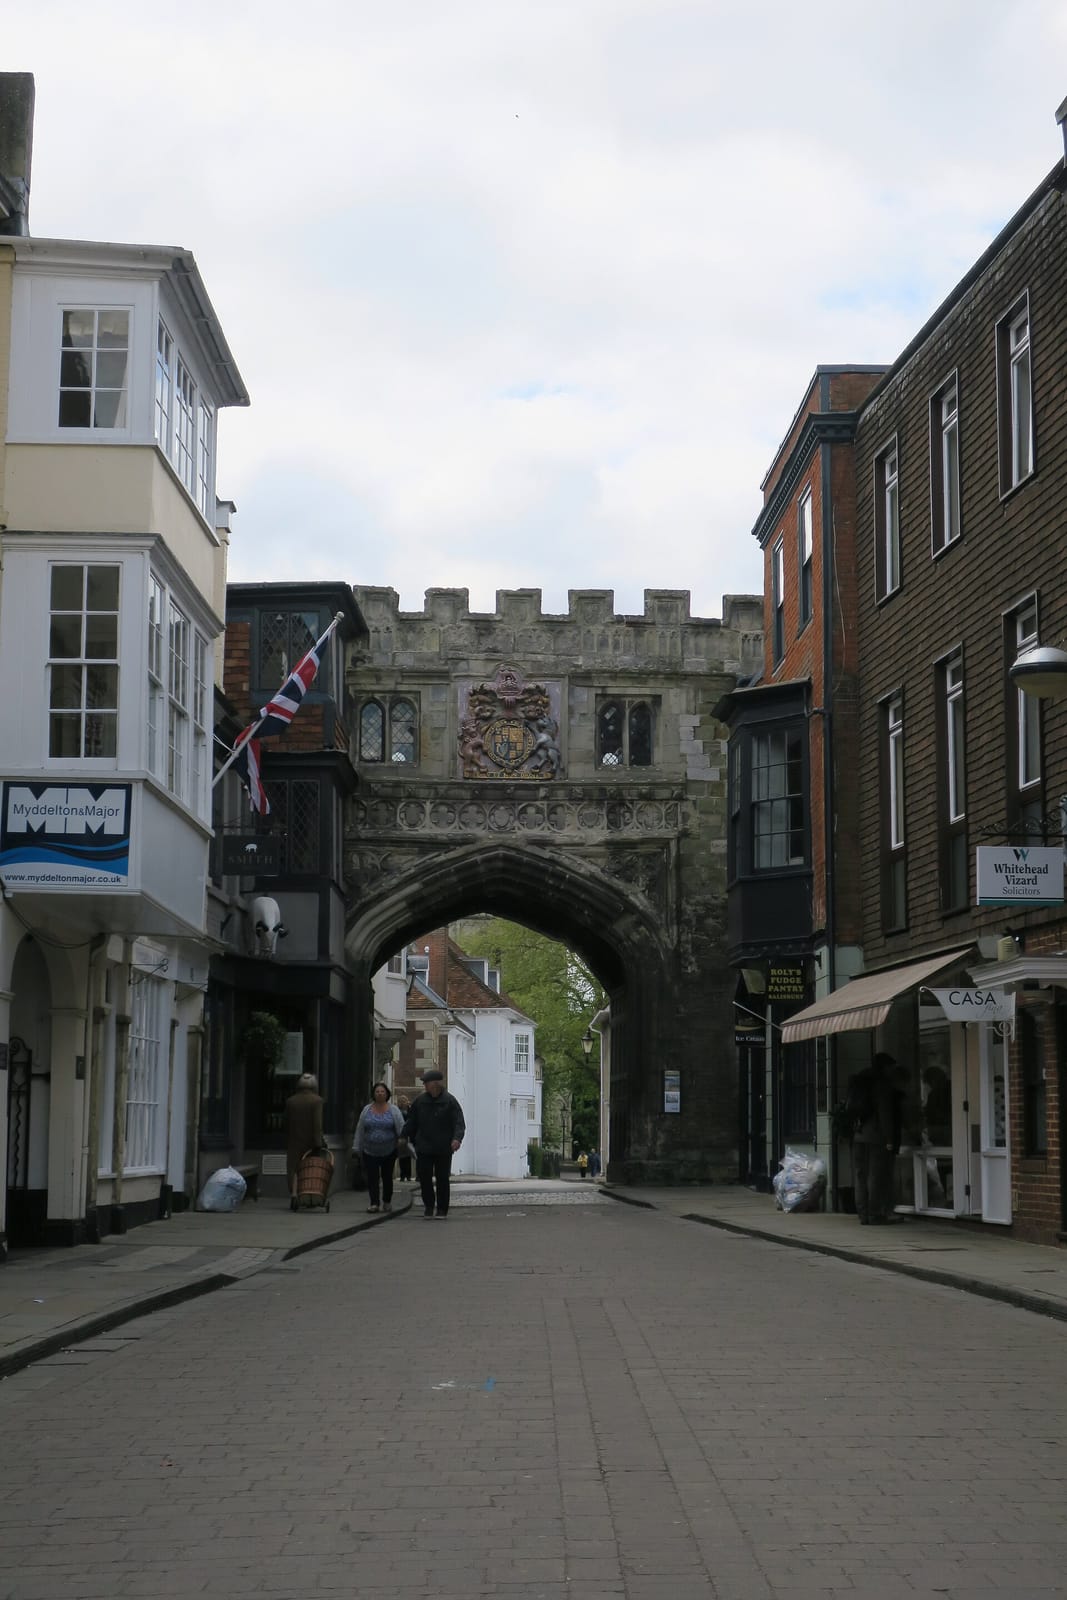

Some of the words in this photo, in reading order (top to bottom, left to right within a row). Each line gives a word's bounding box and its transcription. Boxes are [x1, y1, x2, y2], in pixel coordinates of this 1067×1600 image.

[13, 804, 120, 818] Myddelton&Major
[994, 863, 1049, 875] Whitehead
[4, 873, 121, 884] www.myddeltonmajor.co.uk
[1005, 874, 1038, 886] Vizard
[1002, 886, 1041, 896] Solicitors
[949, 991, 997, 1006] CASA
